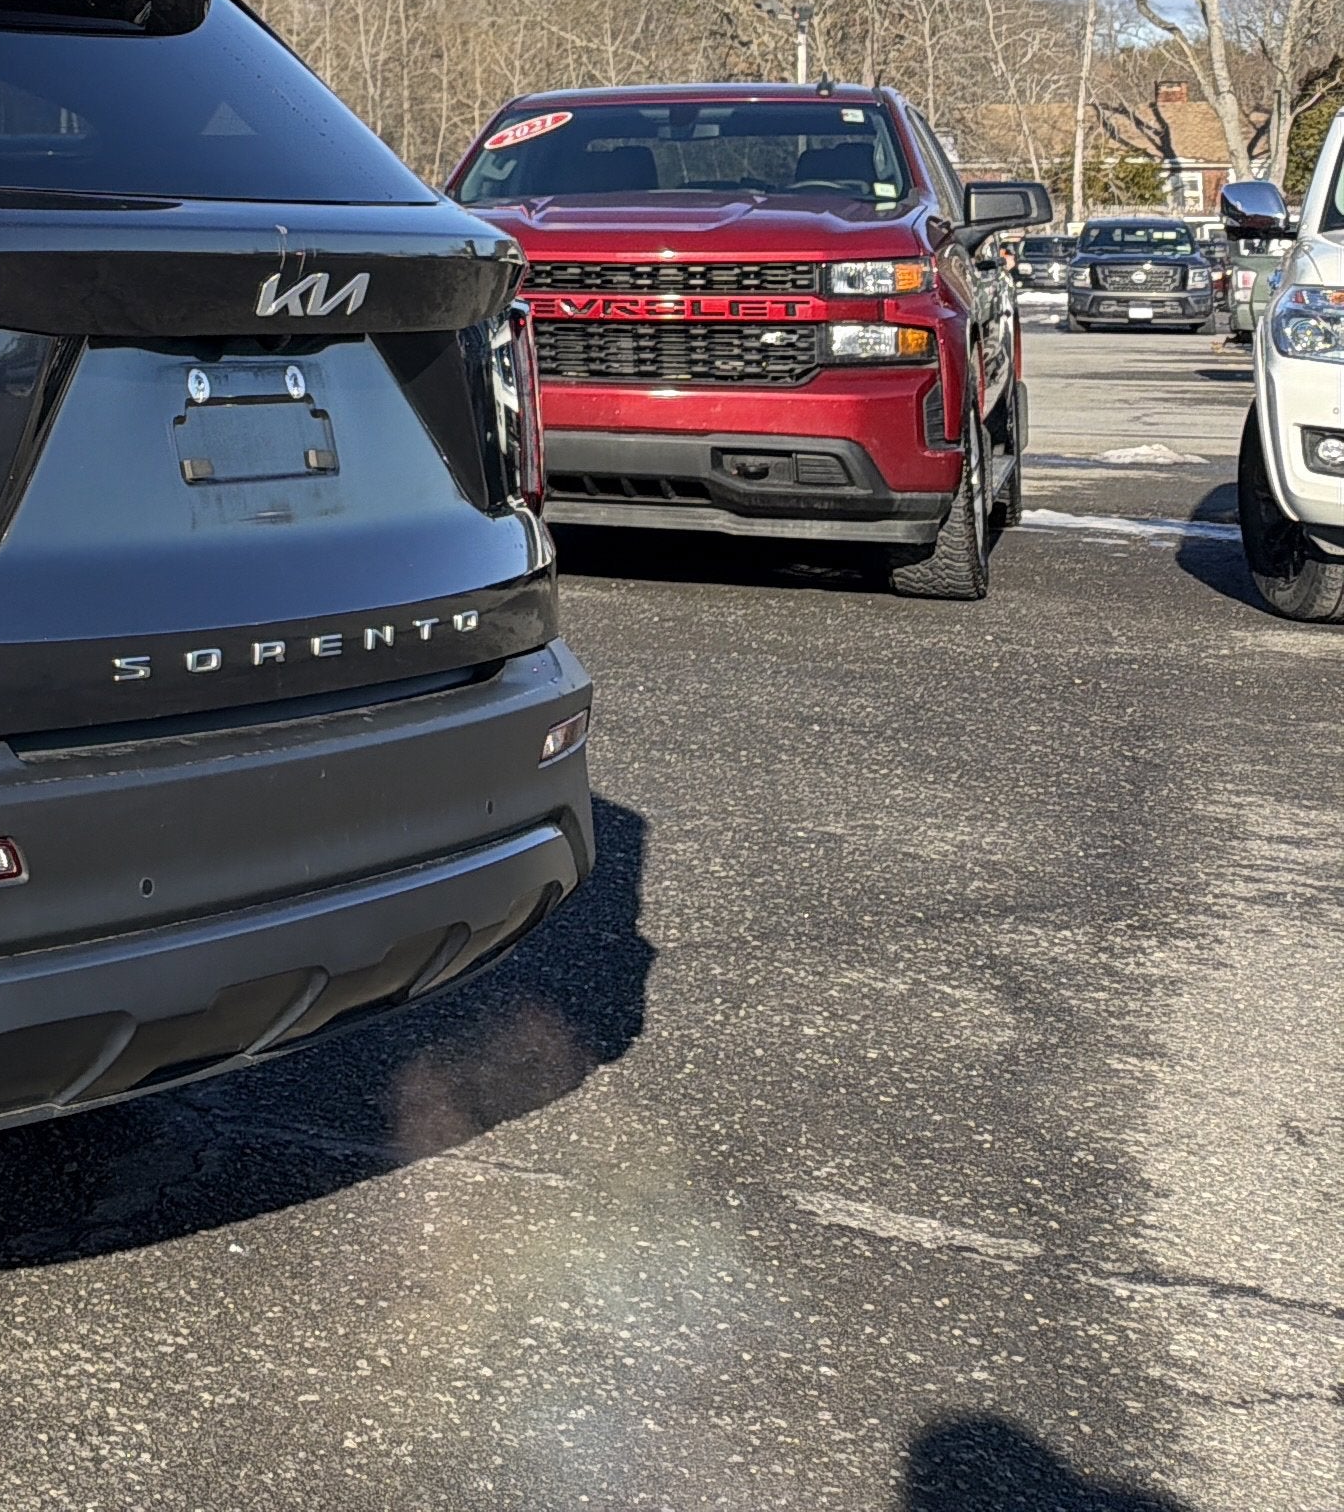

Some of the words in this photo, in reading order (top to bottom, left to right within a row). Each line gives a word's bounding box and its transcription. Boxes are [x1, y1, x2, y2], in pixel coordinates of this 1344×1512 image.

[504, 115, 554, 144] 2021
[530, 298, 811, 318] EVROLET
[112, 609, 480, 682] SORENTO
